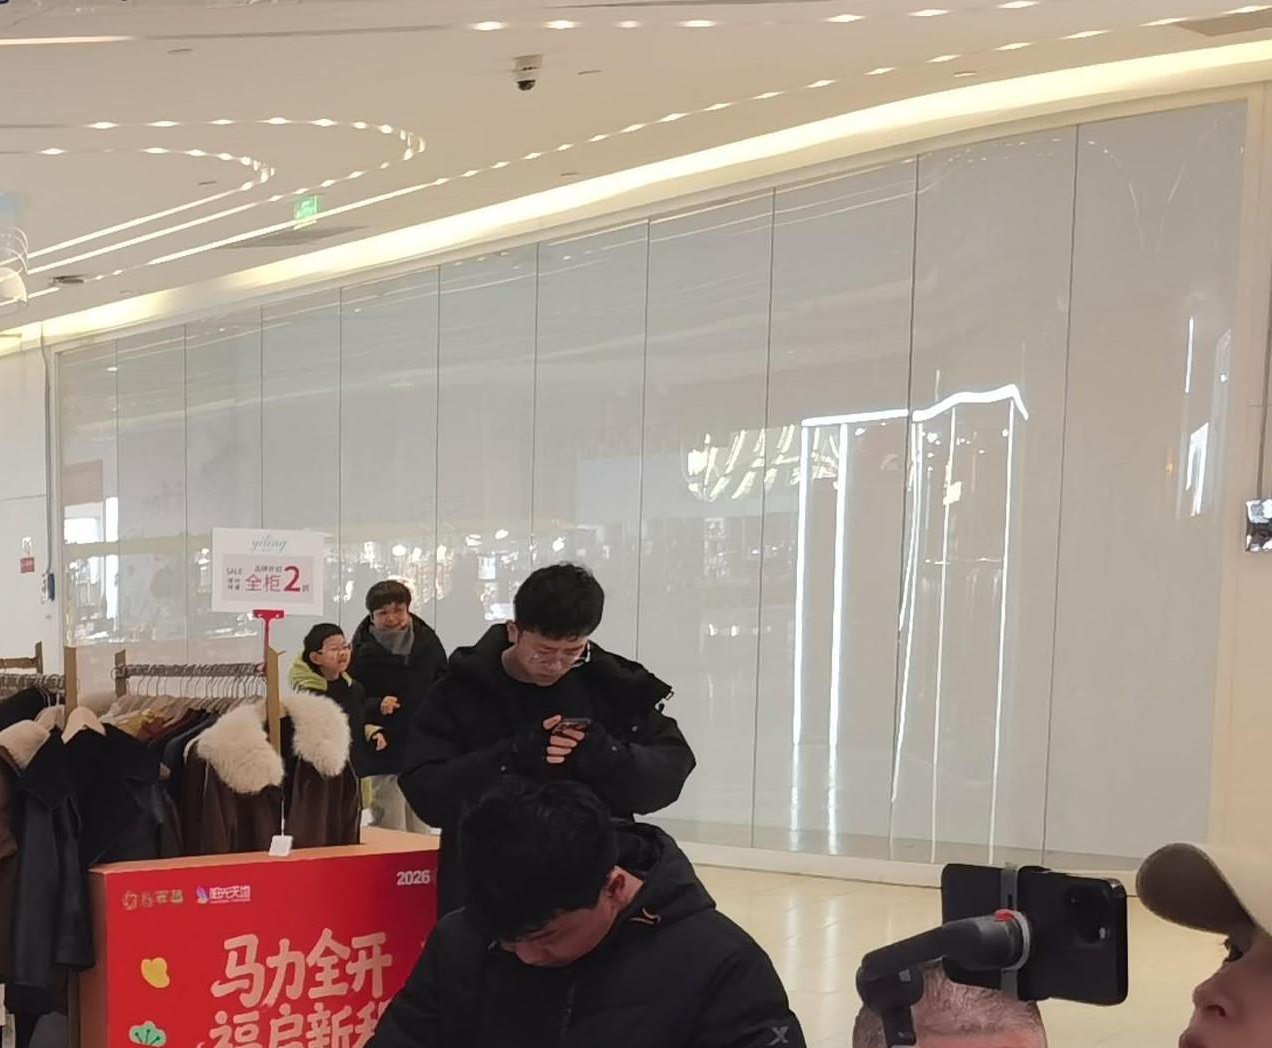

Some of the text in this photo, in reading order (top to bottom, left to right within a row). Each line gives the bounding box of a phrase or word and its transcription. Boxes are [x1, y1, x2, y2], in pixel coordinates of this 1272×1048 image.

[396, 869, 431, 886] 2026
[210, 928, 393, 1008] 马力全开
